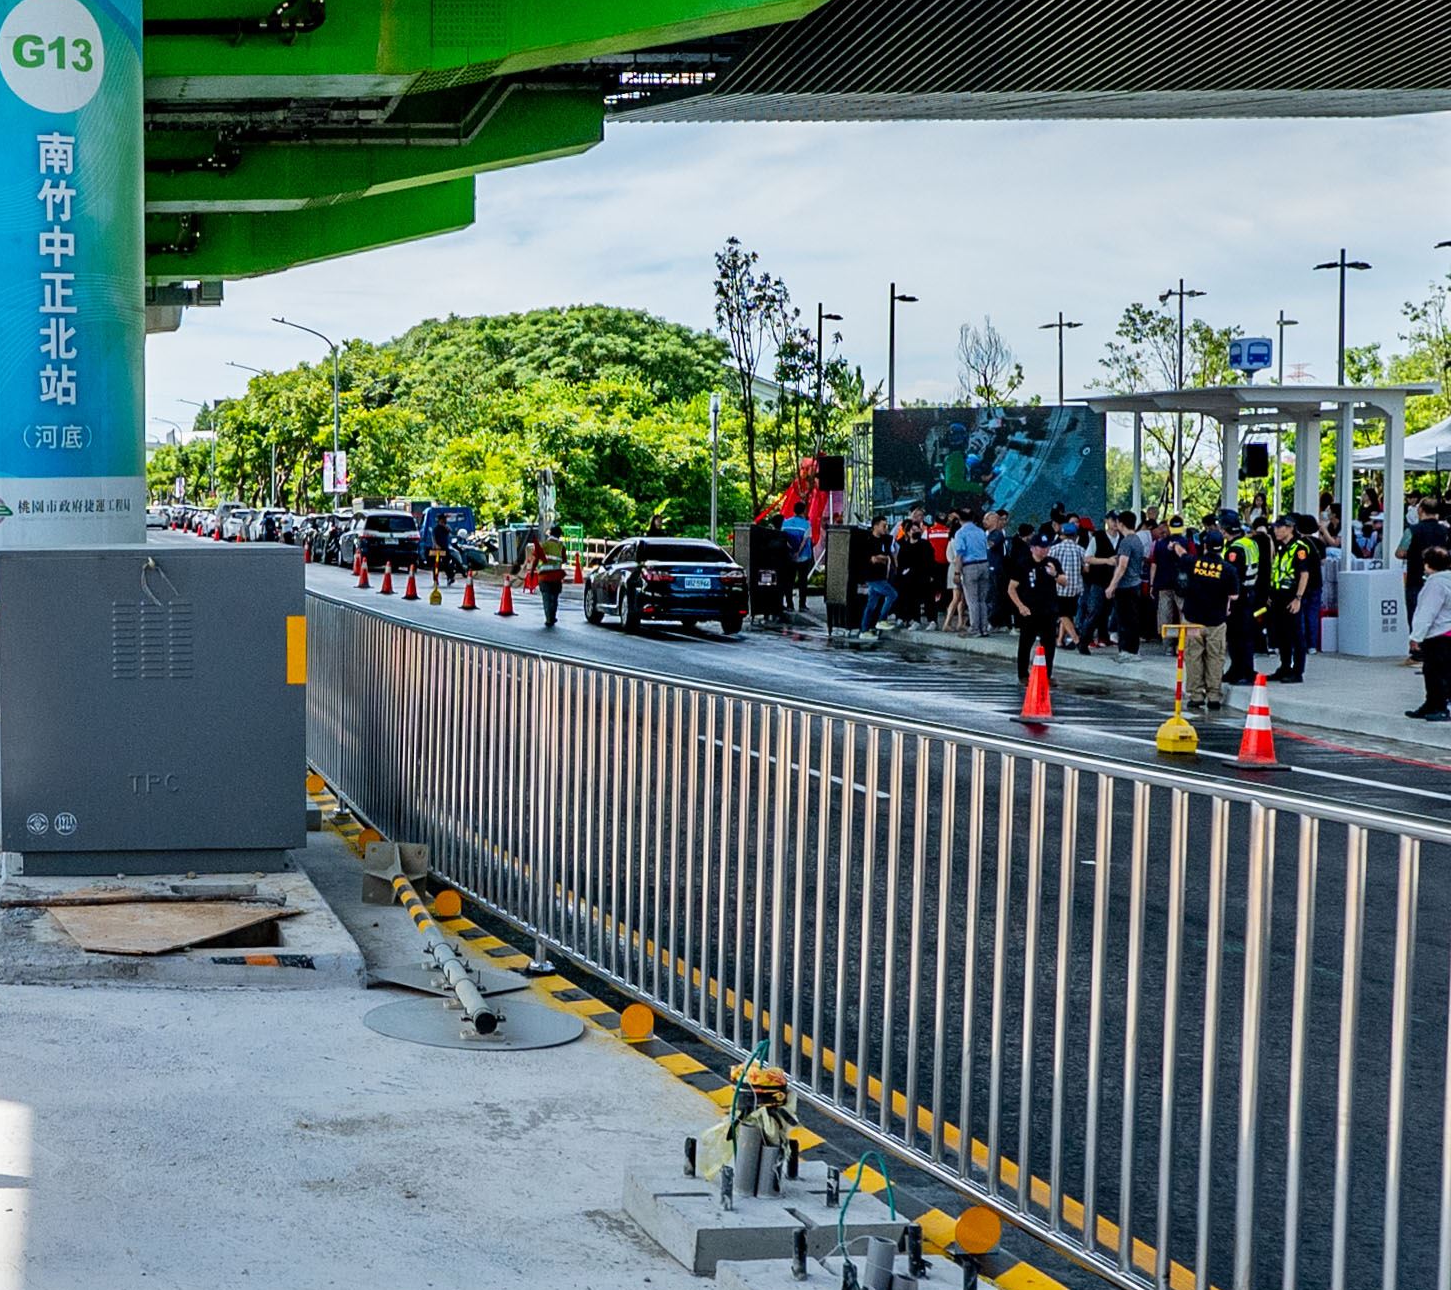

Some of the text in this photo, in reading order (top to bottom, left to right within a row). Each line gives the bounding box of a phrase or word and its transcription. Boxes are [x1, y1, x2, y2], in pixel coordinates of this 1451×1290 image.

[12, 34, 94, 74] G13
[37, 131, 78, 407] 南竹中正北站
[18, 499, 131, 514] 桃園市政府捷運工程局
[1194, 567, 1221, 579] POLICE
[129, 774, 180, 794] TPC
